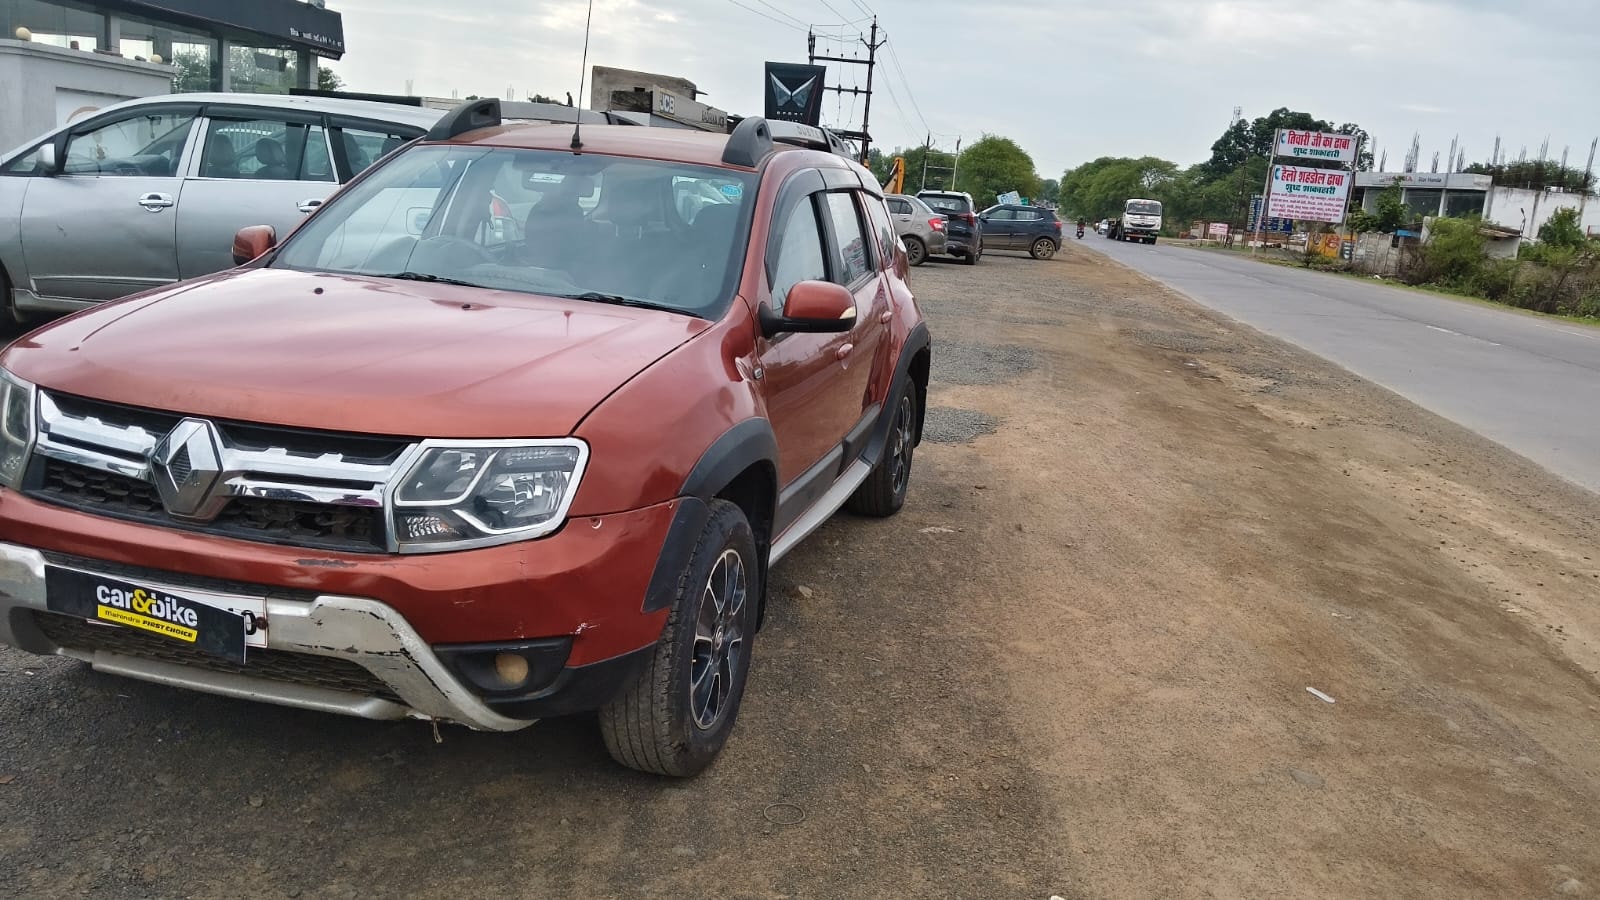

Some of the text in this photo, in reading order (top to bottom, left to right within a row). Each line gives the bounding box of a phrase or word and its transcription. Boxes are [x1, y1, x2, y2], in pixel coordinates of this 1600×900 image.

[659, 91, 675, 114] JCB
[1287, 130, 1350, 150] तिवारी जी का ढाबा
[1298, 168, 1326, 184] शहडोल
[1327, 173, 1344, 186] ढाबा
[96, 585, 198, 627] car&bike
[142, 619, 165, 630] FIRST
[165, 626, 193, 638] CHOICE
